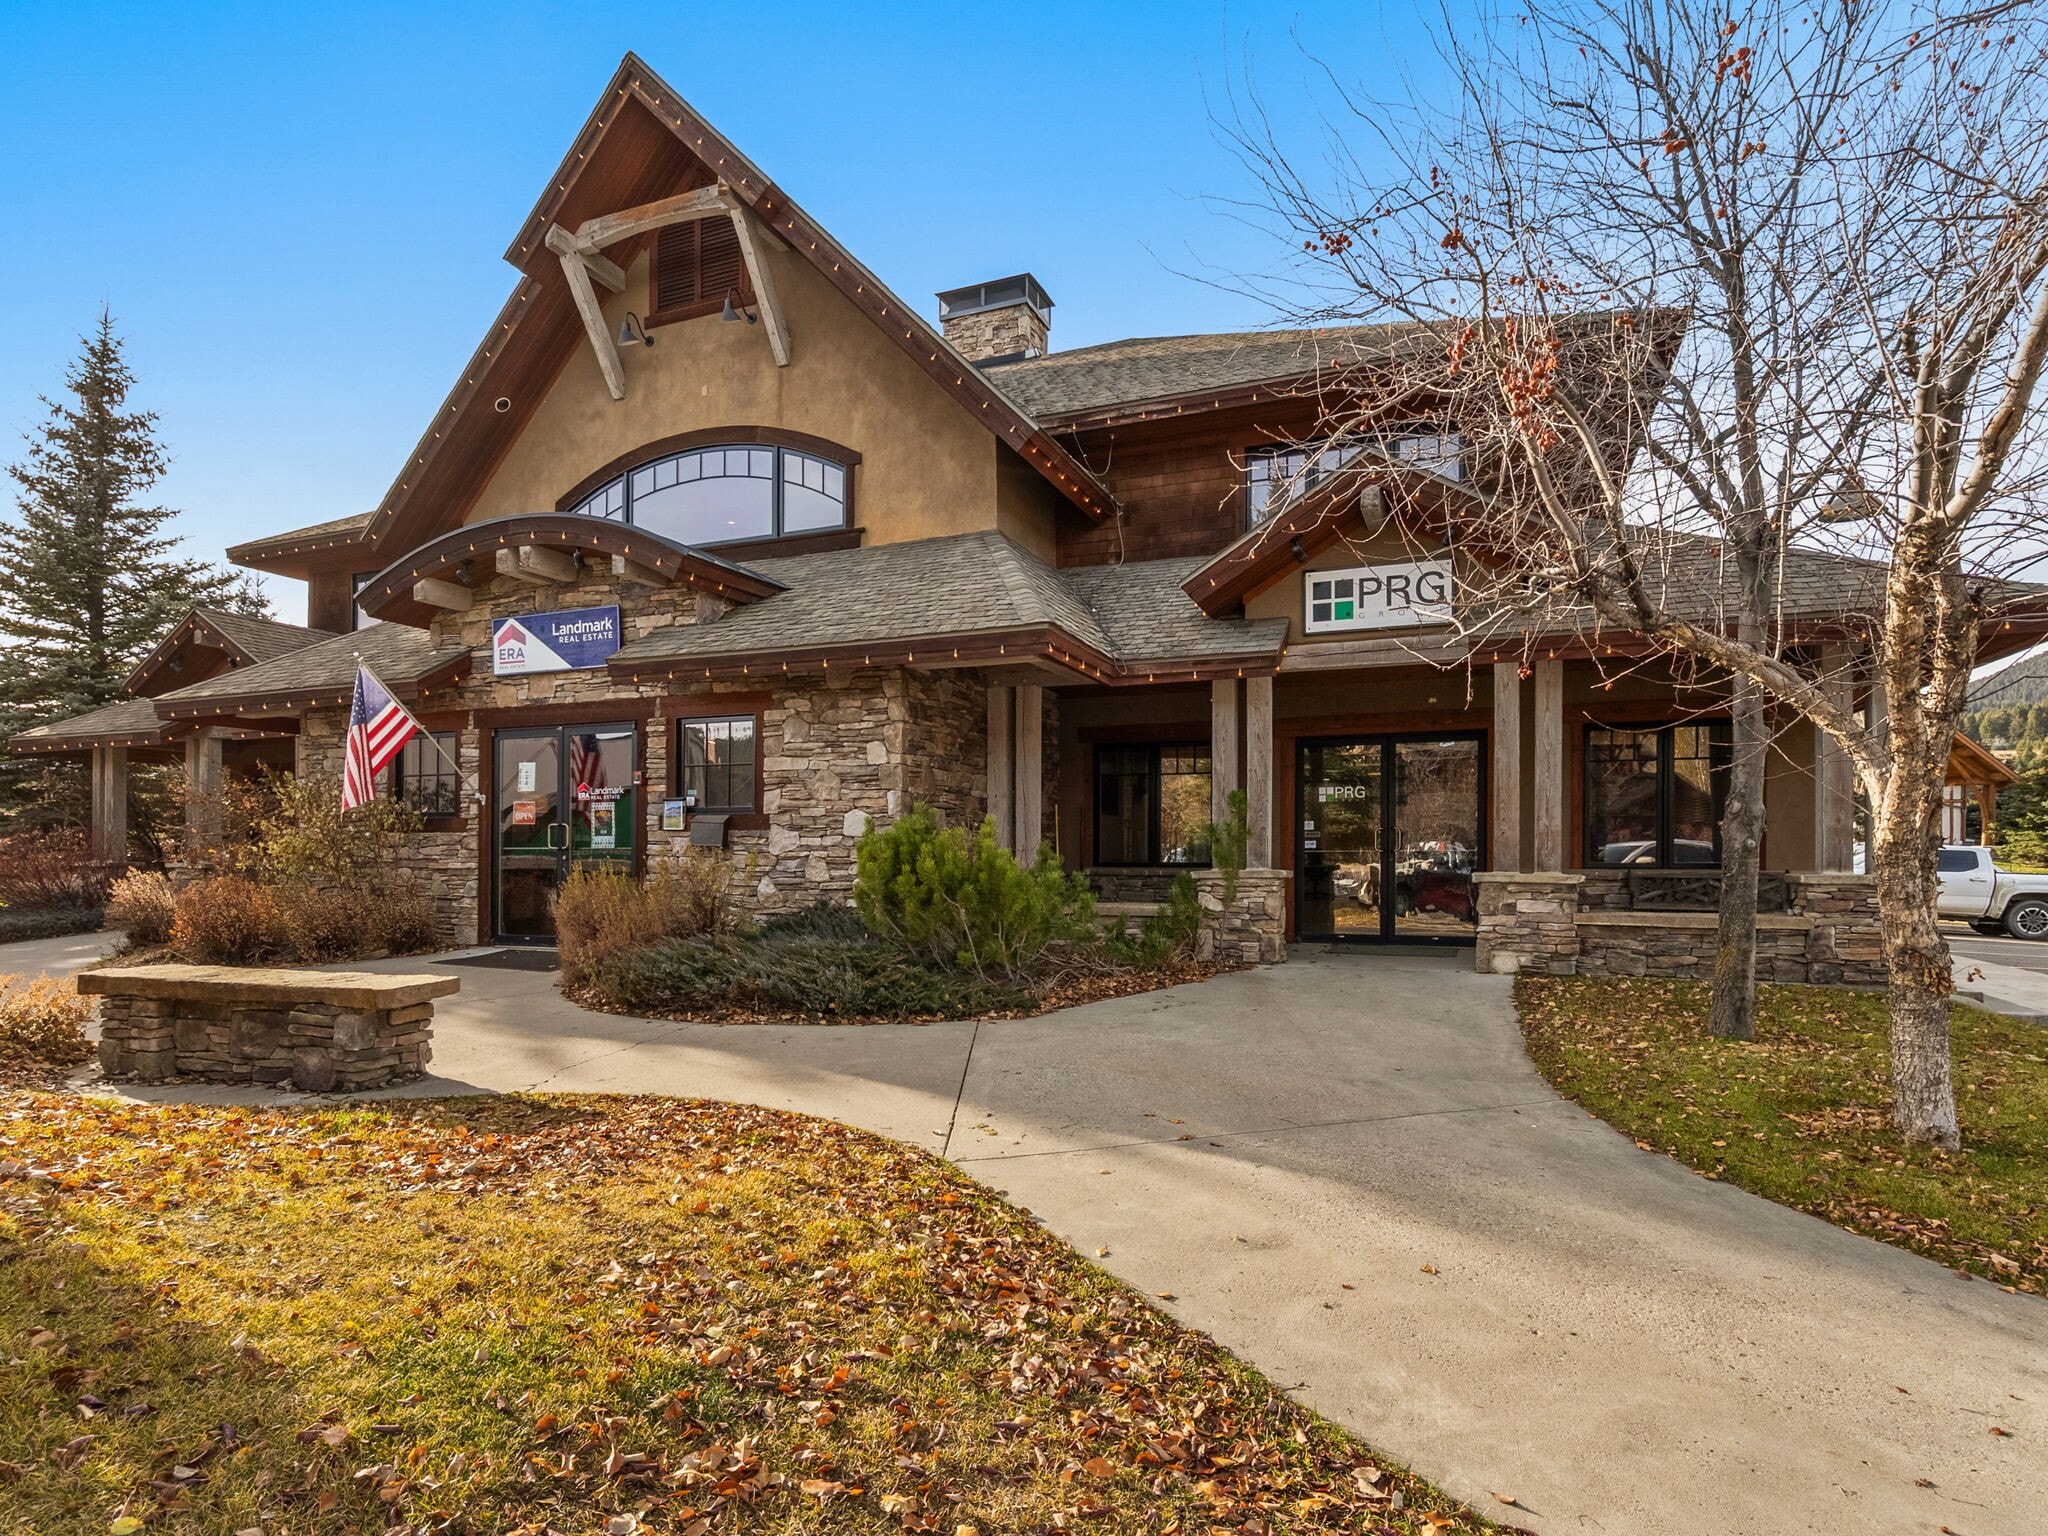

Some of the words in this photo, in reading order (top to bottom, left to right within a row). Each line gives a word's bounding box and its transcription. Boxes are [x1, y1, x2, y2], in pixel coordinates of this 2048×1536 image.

[1358, 571, 1446, 609] PRG
[552, 617, 613, 636] Landmark
[558, 635, 580, 644] REAL
[583, 632, 613, 642] ESTATE
[499, 647, 525, 661] ERA
[590, 786, 624, 795] Landmark
[1335, 785, 1366, 798] PRG
[515, 811, 534, 820] OPEN
